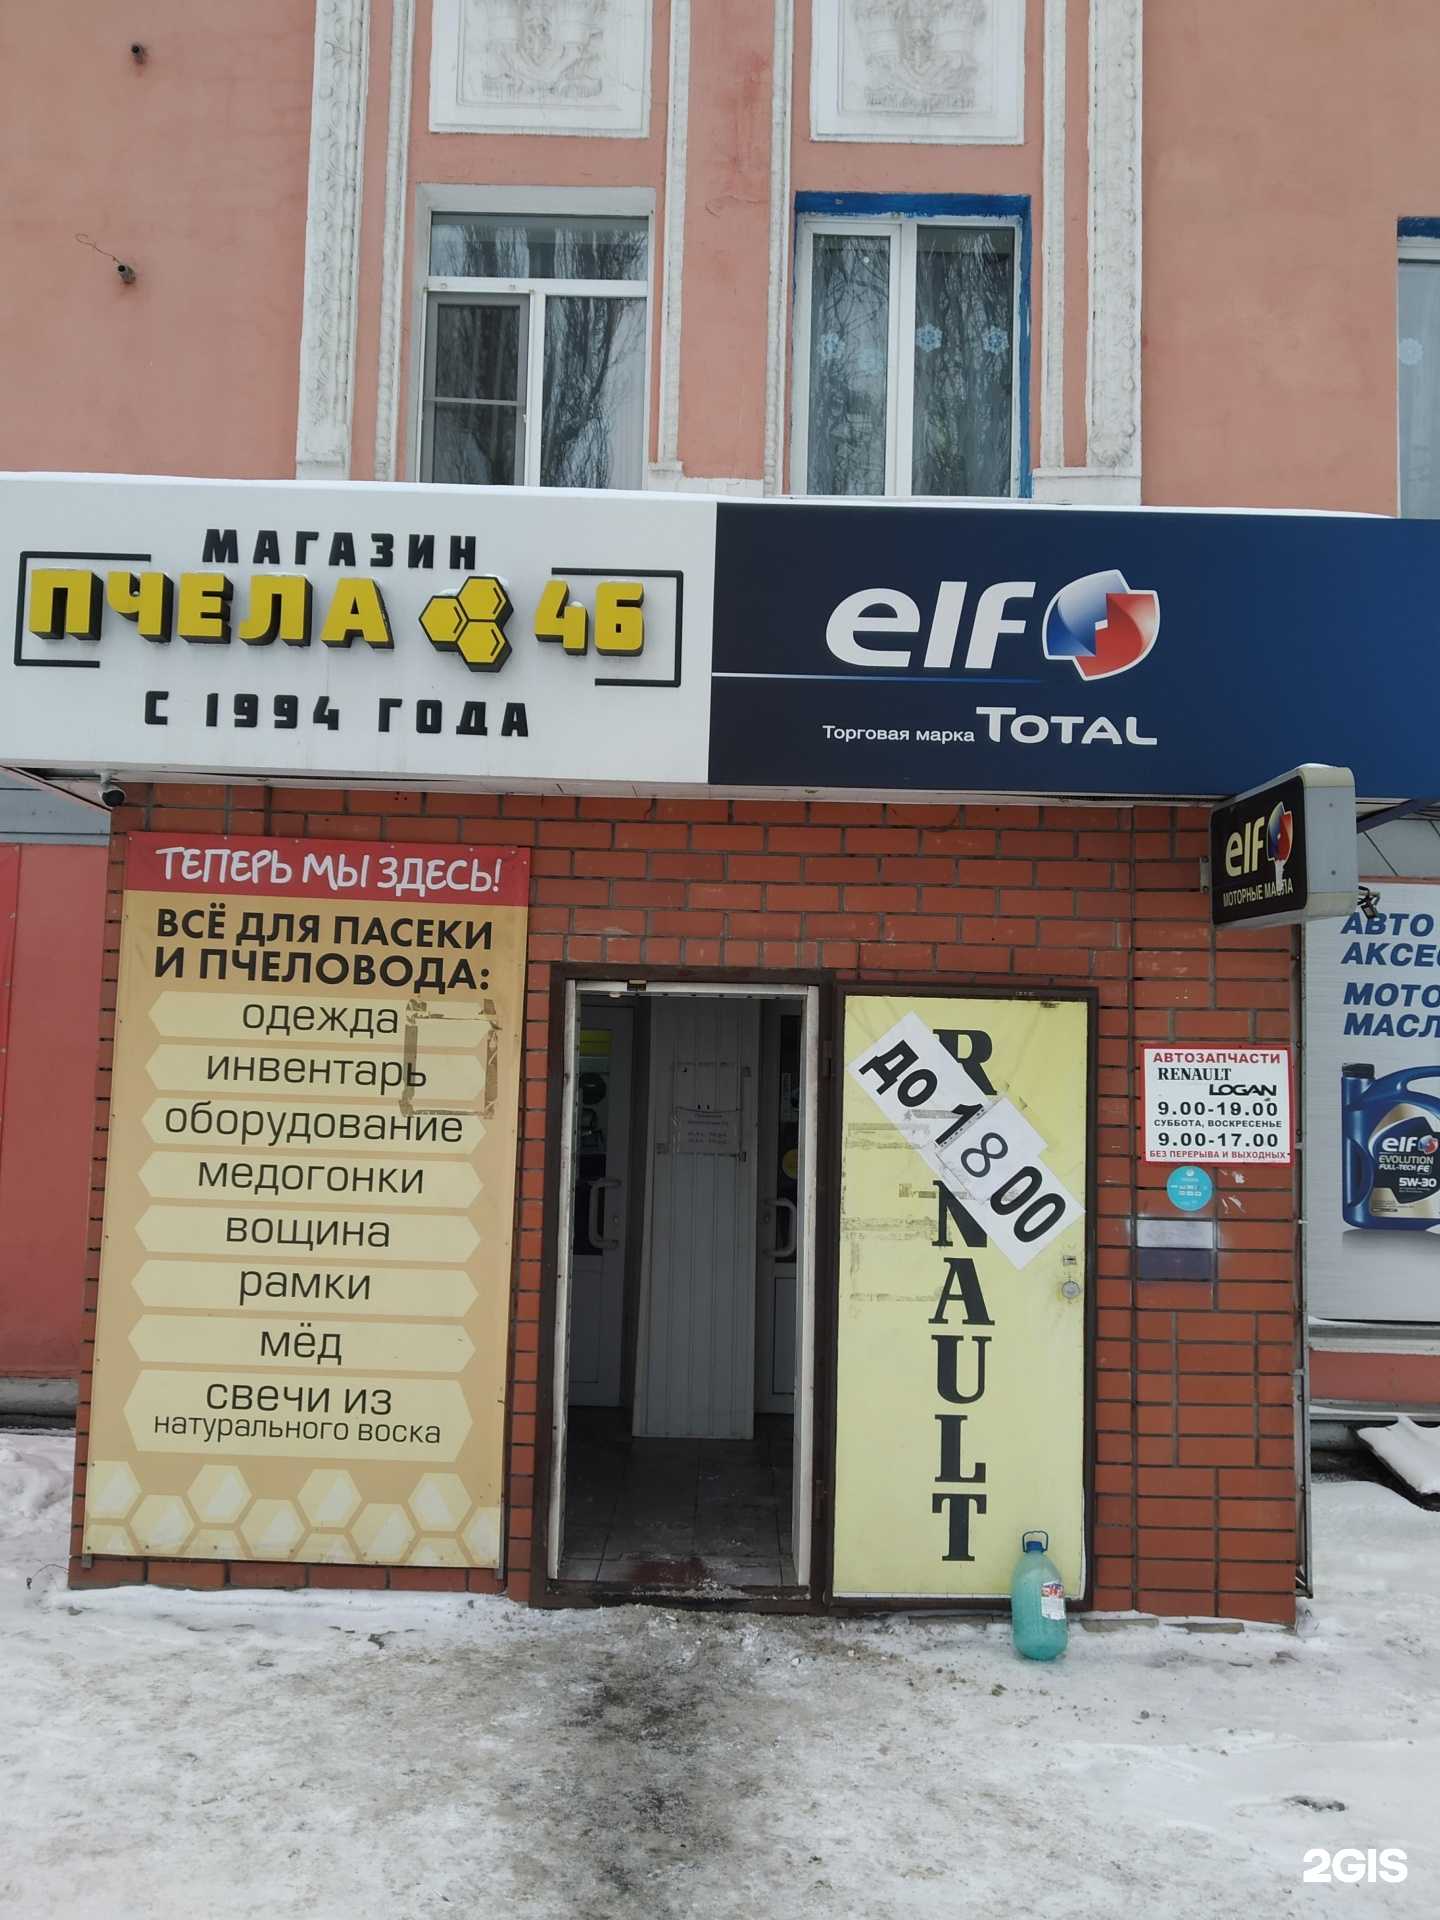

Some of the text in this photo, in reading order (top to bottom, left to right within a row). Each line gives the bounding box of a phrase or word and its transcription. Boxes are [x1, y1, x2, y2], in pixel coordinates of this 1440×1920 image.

[202, 528, 477, 570] МАГАЗИН
[28, 568, 645, 657] ПЧЕЛА 46
[825, 580, 1036, 670] elf
[144, 690, 530, 738] С 1994 ГОДА
[822, 724, 910, 743] Торговая
[915, 728, 975, 744] марка
[1225, 815, 1265, 878] elf
[156, 846, 502, 897] ТЕПЕРЬ МЫ ЗДЕСЬ!
[1223, 884, 1263, 907] МОТОРНЫЕ
[156, 902, 493, 949] ВСЁ ДЛЯ ПАСЕКИ
[1340, 911, 1434, 937] АВТО
[1340, 941, 1440, 967] АКСЕ
[154, 946, 490, 994] И ПЧЕЛОВОДА:
[1343, 982, 1440, 1008] МОТО
[242, 1002, 399, 1038] одежда
[1343, 1012, 1440, 1038] МАСЛ
[1153, 1052, 1281, 1064] АВТОЗАПЧАСТИ
[207, 1055, 427, 1096] инвентарь
[1157, 1067, 1232, 1081] RENAULT
[1208, 1083, 1277, 1096] LOGAN
[165, 1101, 463, 1145] оборудование
[1153, 1119, 1282, 1128] СУББОТА, ВОСКРЕСЕНЬЕ
[1157, 1101, 1278, 1116] 9.00-19.00
[1149, 1150, 1167, 1158] БЕЗ
[1169, 1150, 1219, 1158] ПЕРЕРЫВА
[1231, 1151, 1286, 1159] ВЫХОДНЫХ
[1158, 1132, 1278, 1147] 9.00-17.00
[1382, 1136, 1418, 1152] elf
[1378, 1155, 1434, 1165] EVOLUTION
[198, 1160, 424, 1195] медогонки
[1399, 1177, 1437, 1188] 5W-30
[226, 1216, 391, 1251] вощина
[240, 1269, 371, 1305] рамки
[928, 1028, 997, 1562] RNAULT
[260, 1322, 342, 1365] мёд
[206, 1383, 392, 1415] свечи из
[154, 1415, 441, 1444] натурального воска
